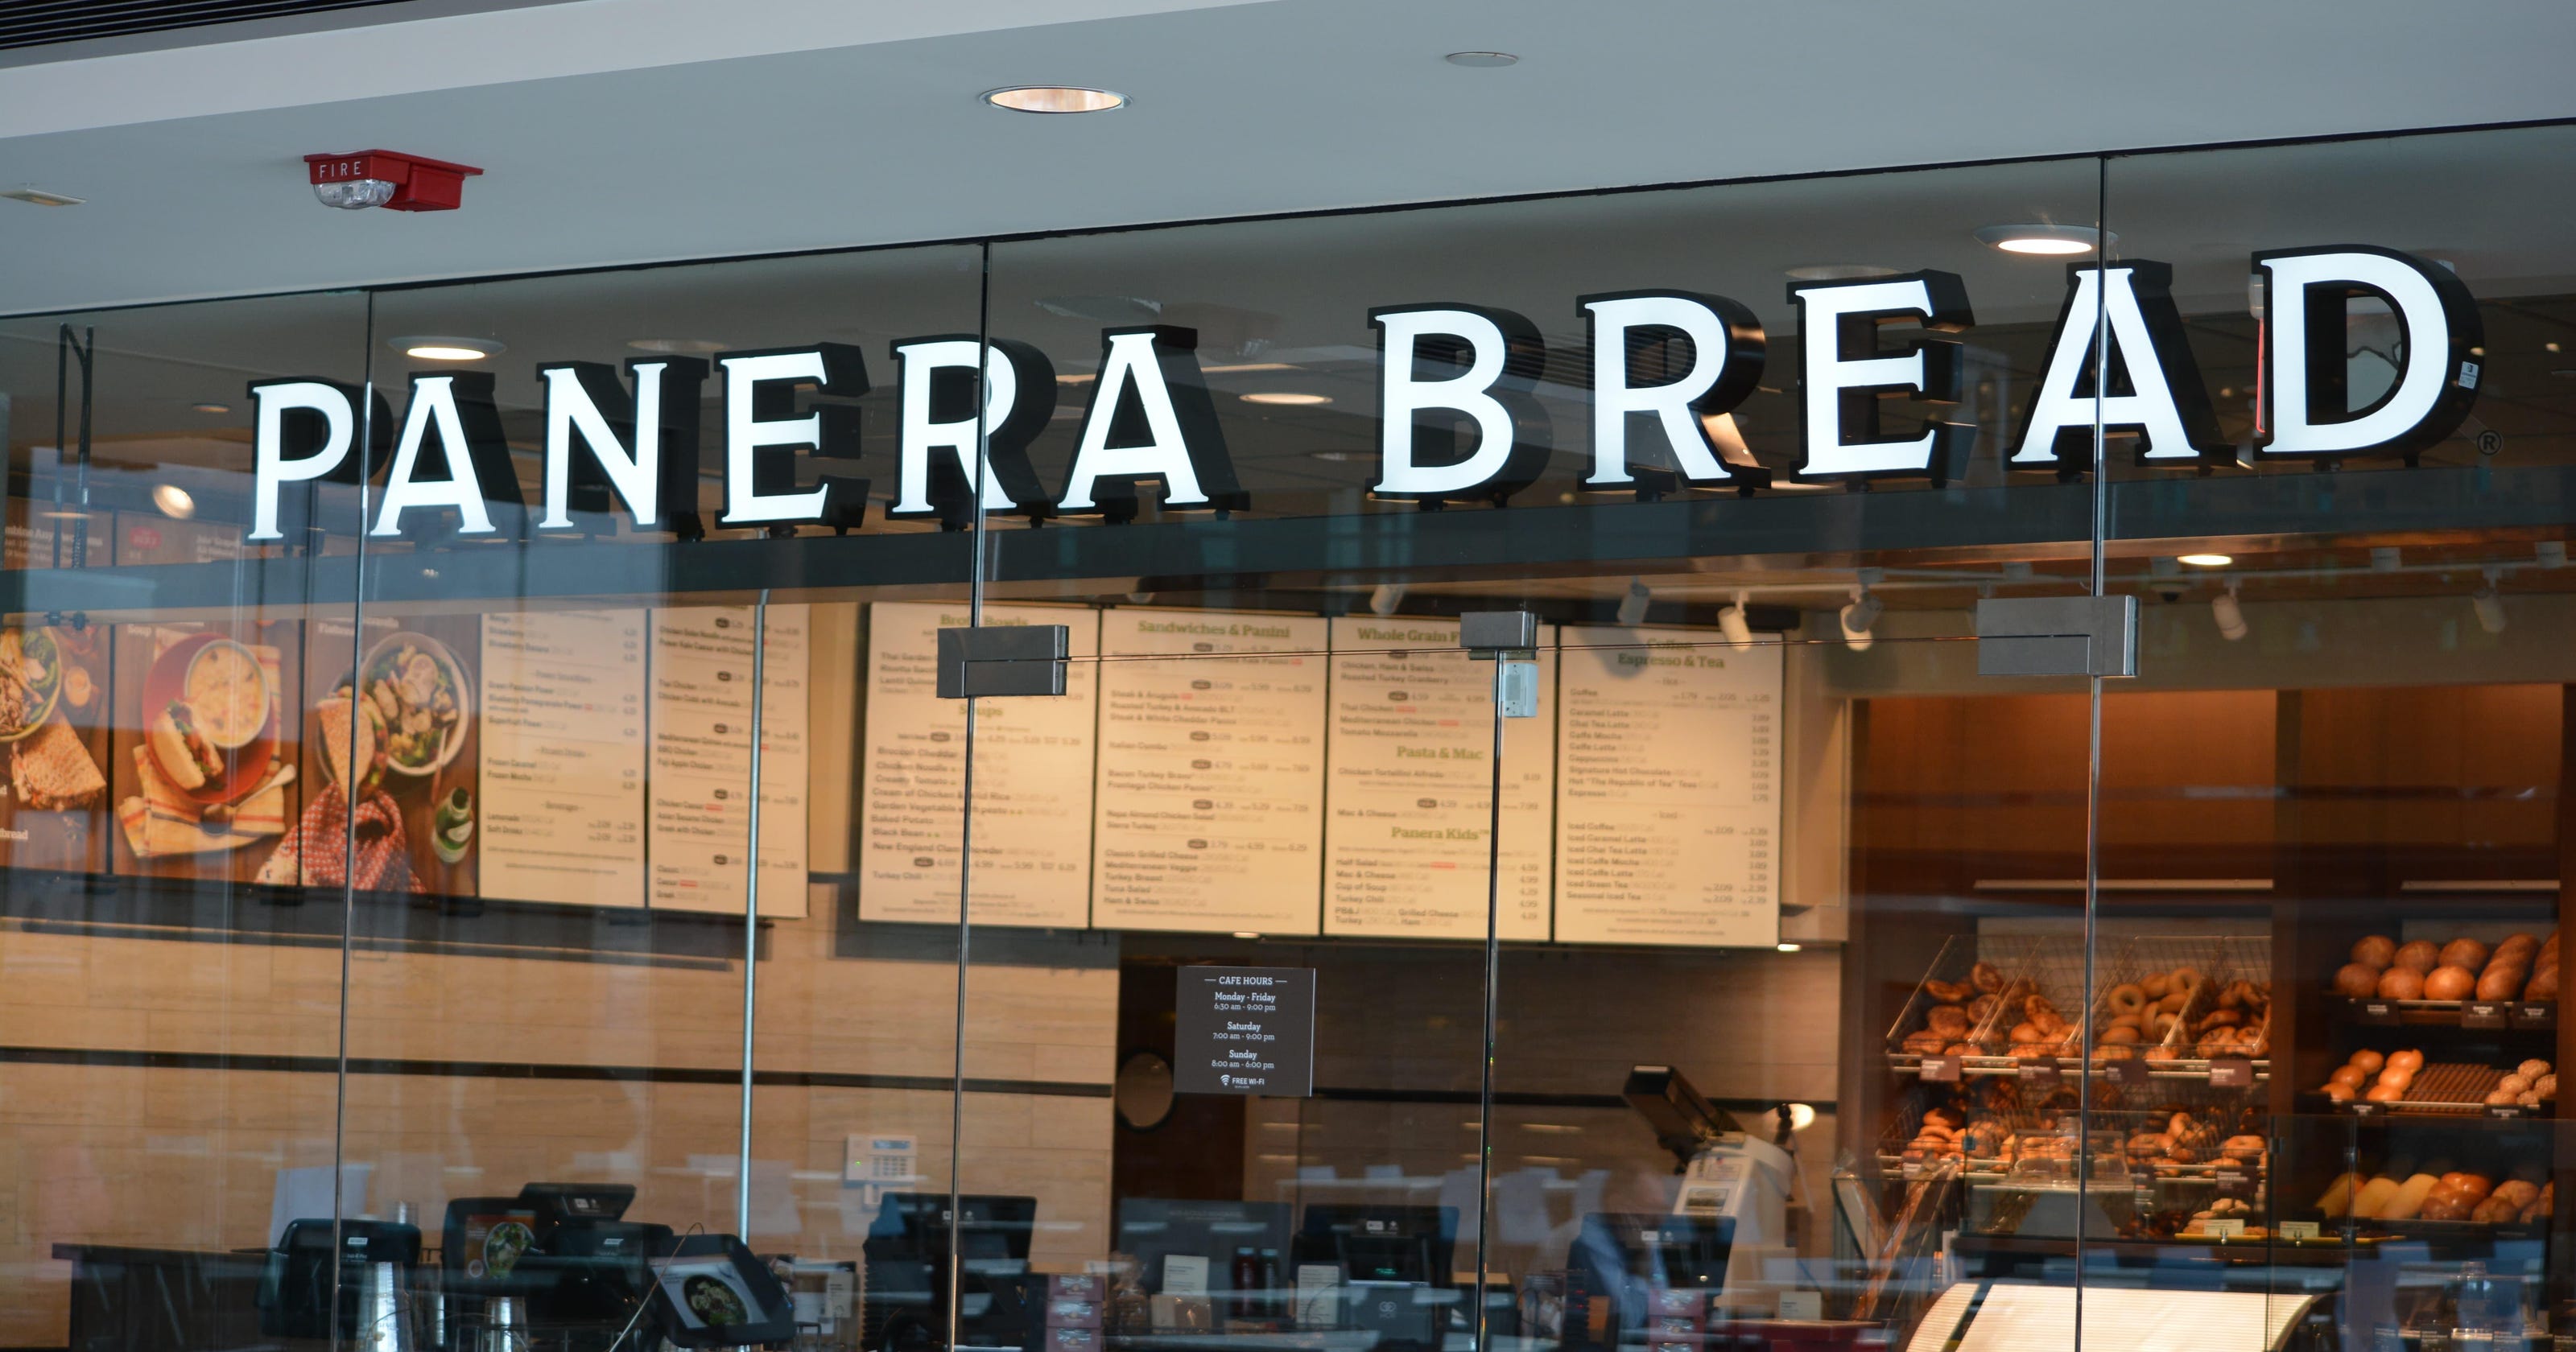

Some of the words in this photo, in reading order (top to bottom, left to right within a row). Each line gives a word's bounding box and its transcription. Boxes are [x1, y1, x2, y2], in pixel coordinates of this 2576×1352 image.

[320, 161, 361, 178] FIRE
[250, 332, 1211, 540] PANERA
[1373, 253, 2450, 493] BREAD
[1137, 620, 1226, 635] Sandwiches
[1228, 623, 1241, 635] &
[1243, 624, 1290, 638] Panini
[1357, 628, 1404, 641] Whole
[1406, 629, 1449, 642] Grain
[1618, 653, 1681, 668] Espresso
[1683, 656, 1695, 667] &
[1698, 656, 1724, 669] Tea
[960, 705, 1003, 718] Sups
[1396, 746, 1435, 759] Pasta
[1439, 747, 1450, 758] &
[1452, 748, 1484, 760] Mac
[1392, 827, 1443, 839] Panera
[1219, 976, 1241, 985] CAFE
[1243, 977, 1273, 985] HOURS
[1215, 992, 1245, 1002] Monday
[1251, 992, 1276, 1003] Friday
[1228, 1021, 1261, 1032] Saturday
[1229, 1050, 1257, 1060] Sunday
